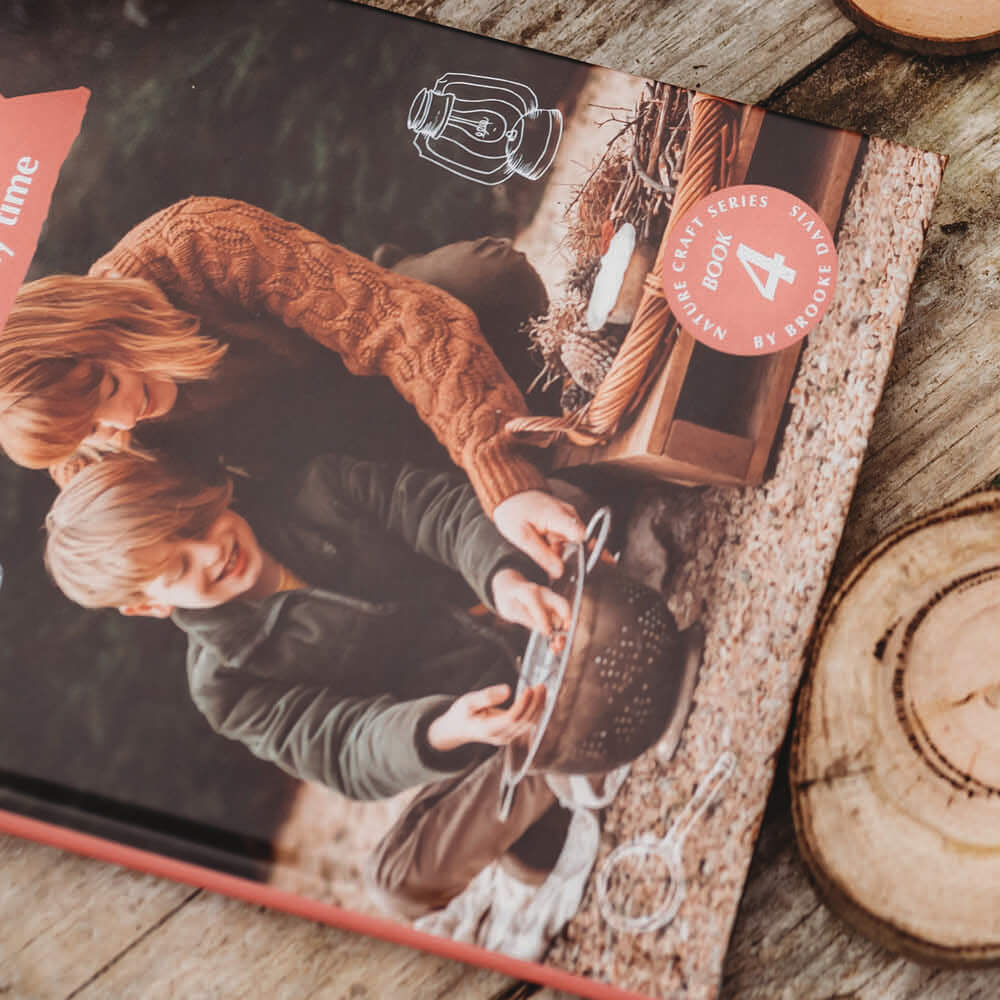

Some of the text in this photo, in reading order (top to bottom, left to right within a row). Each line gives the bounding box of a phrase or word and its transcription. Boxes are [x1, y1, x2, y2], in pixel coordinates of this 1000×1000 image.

[672, 195, 769, 341] NATURE CRAFT SERIES
[701, 230, 733, 291] BOOK
[736, 243, 797, 302] 4
[753, 205, 832, 349] BY BROOKE DAVIS
